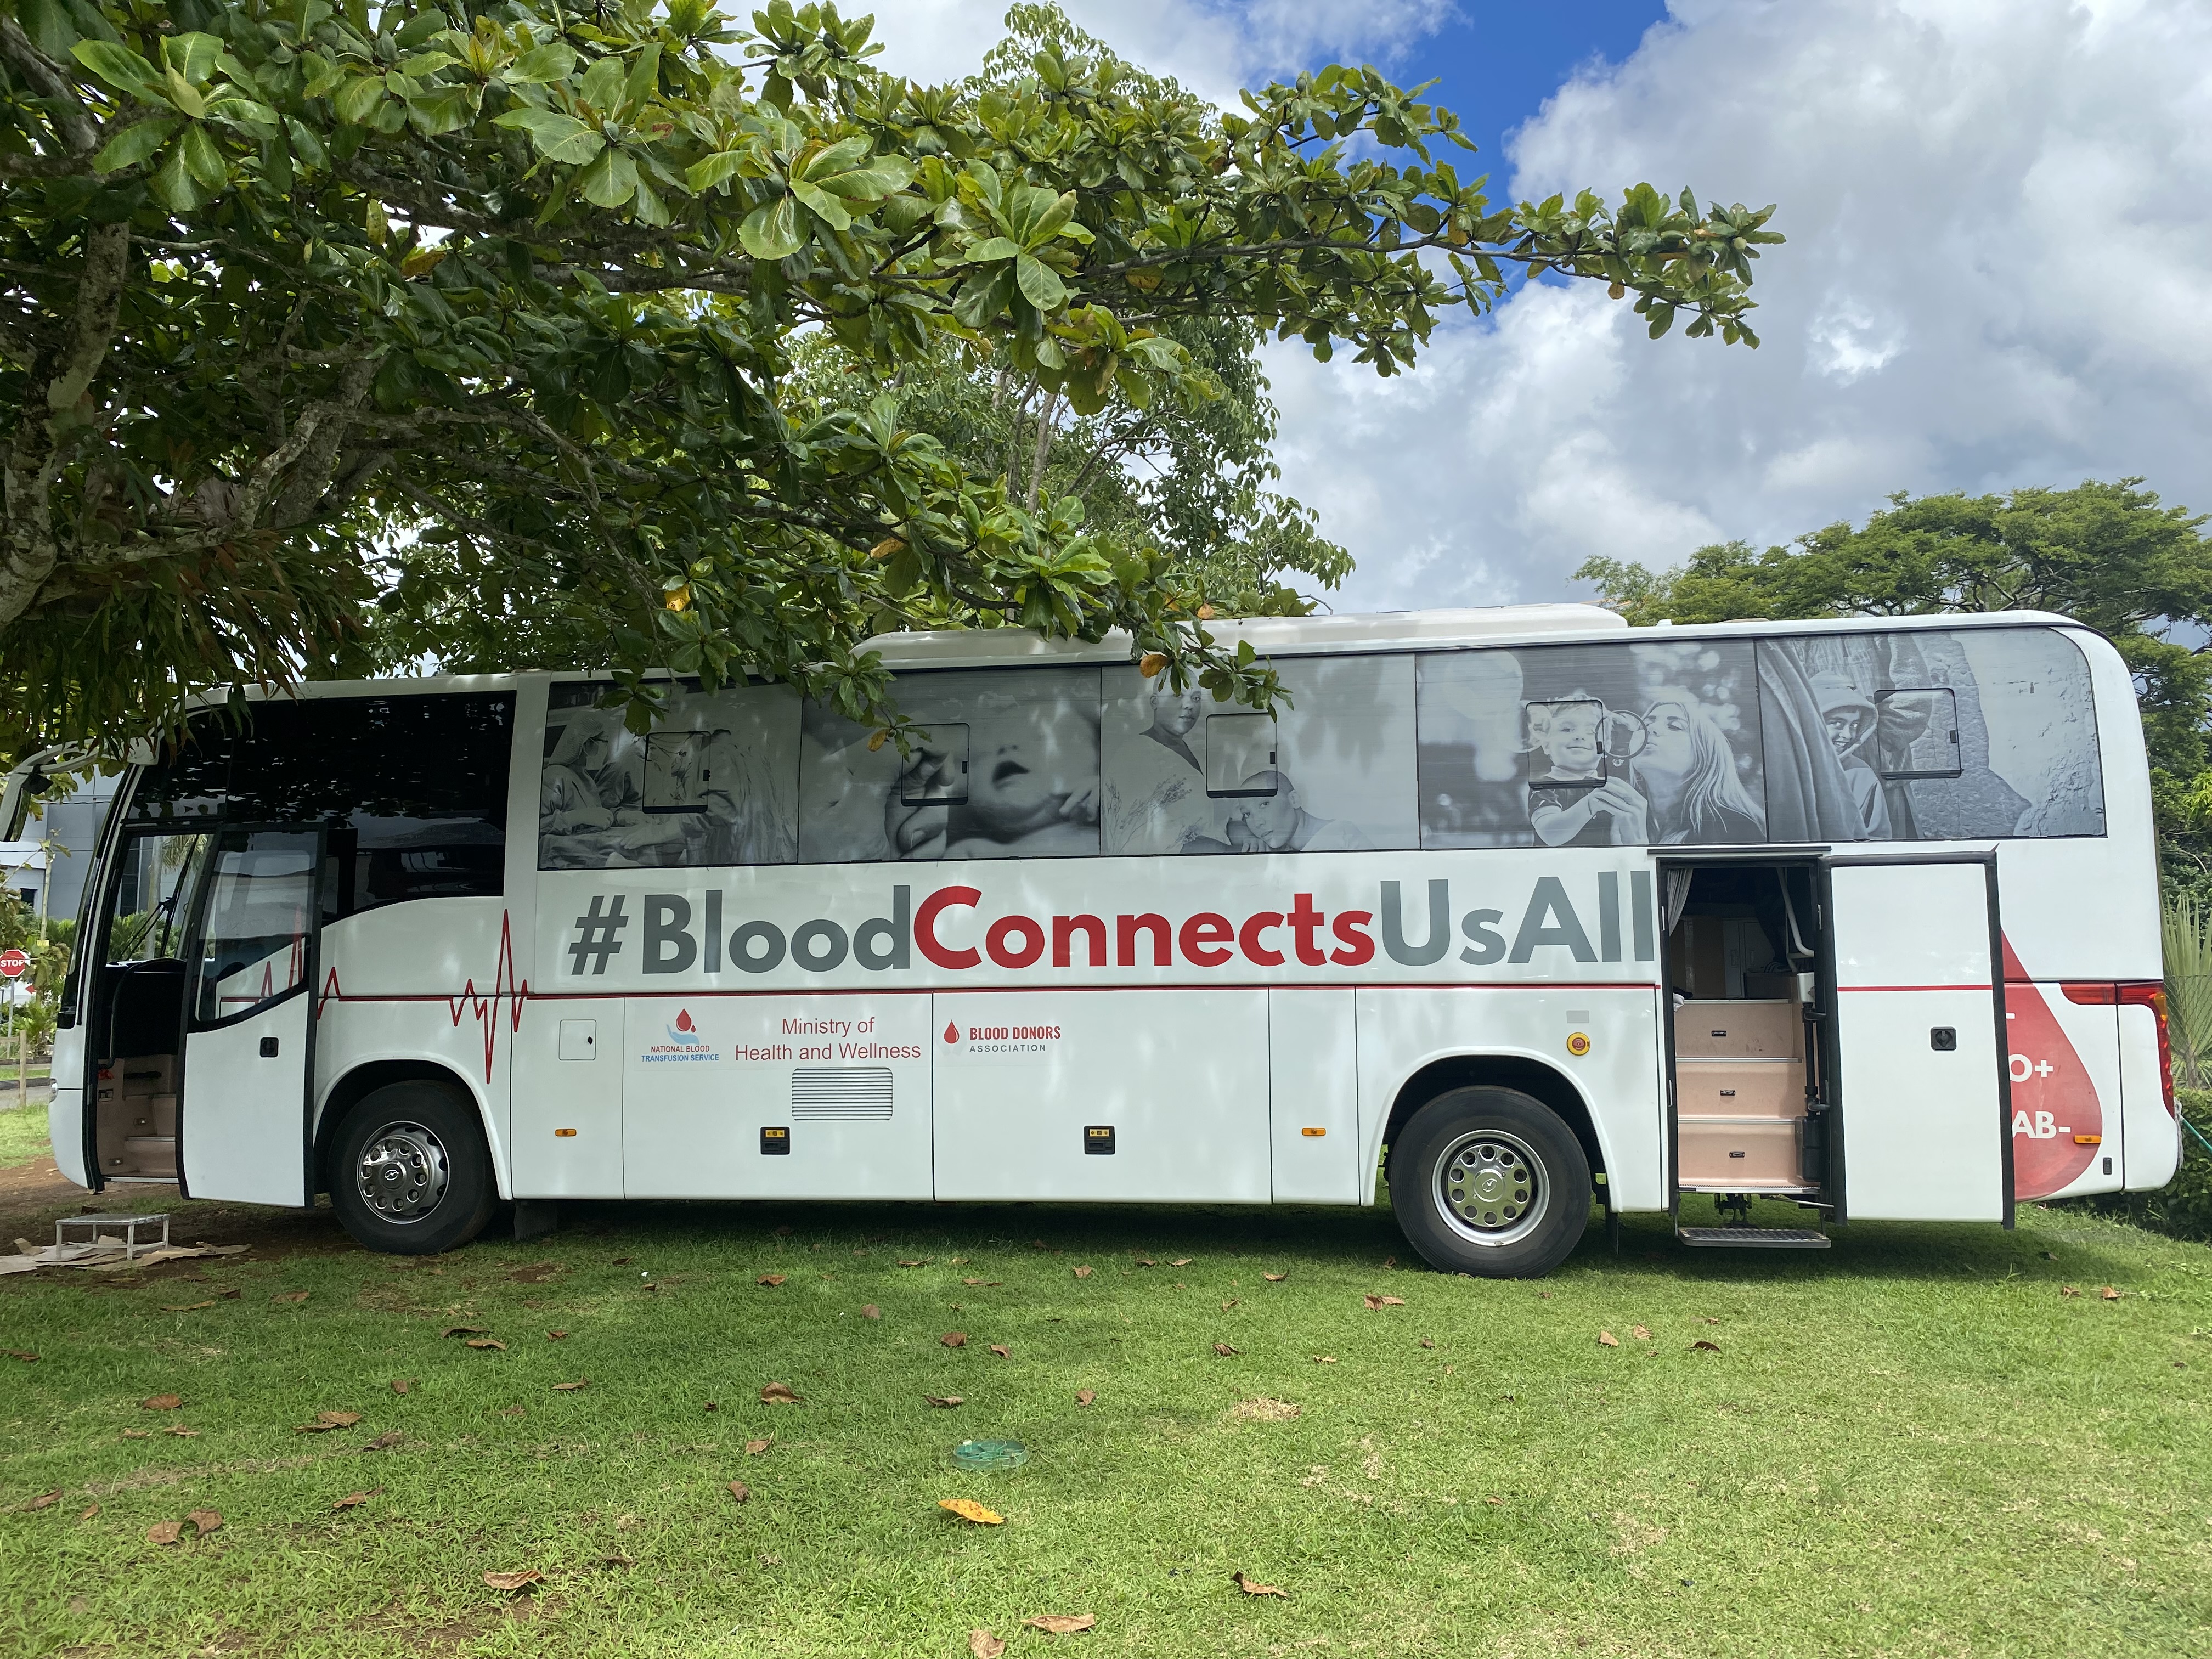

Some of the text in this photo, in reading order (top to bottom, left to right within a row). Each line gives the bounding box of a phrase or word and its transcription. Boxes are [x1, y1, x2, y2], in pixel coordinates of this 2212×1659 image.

[568, 870, 1655, 975] #BloodConnectsUsAll
[782, 1017, 875, 1037] Ministry of
[969, 1026, 1061, 1040] BLOOD DONORS
[735, 1043, 921, 1060] Health and Wellness
[969, 1044, 1046, 1052] ASSOCIATION
[2008, 1053, 2053, 1082] O+
[2012, 1110, 2071, 1139] AB-
